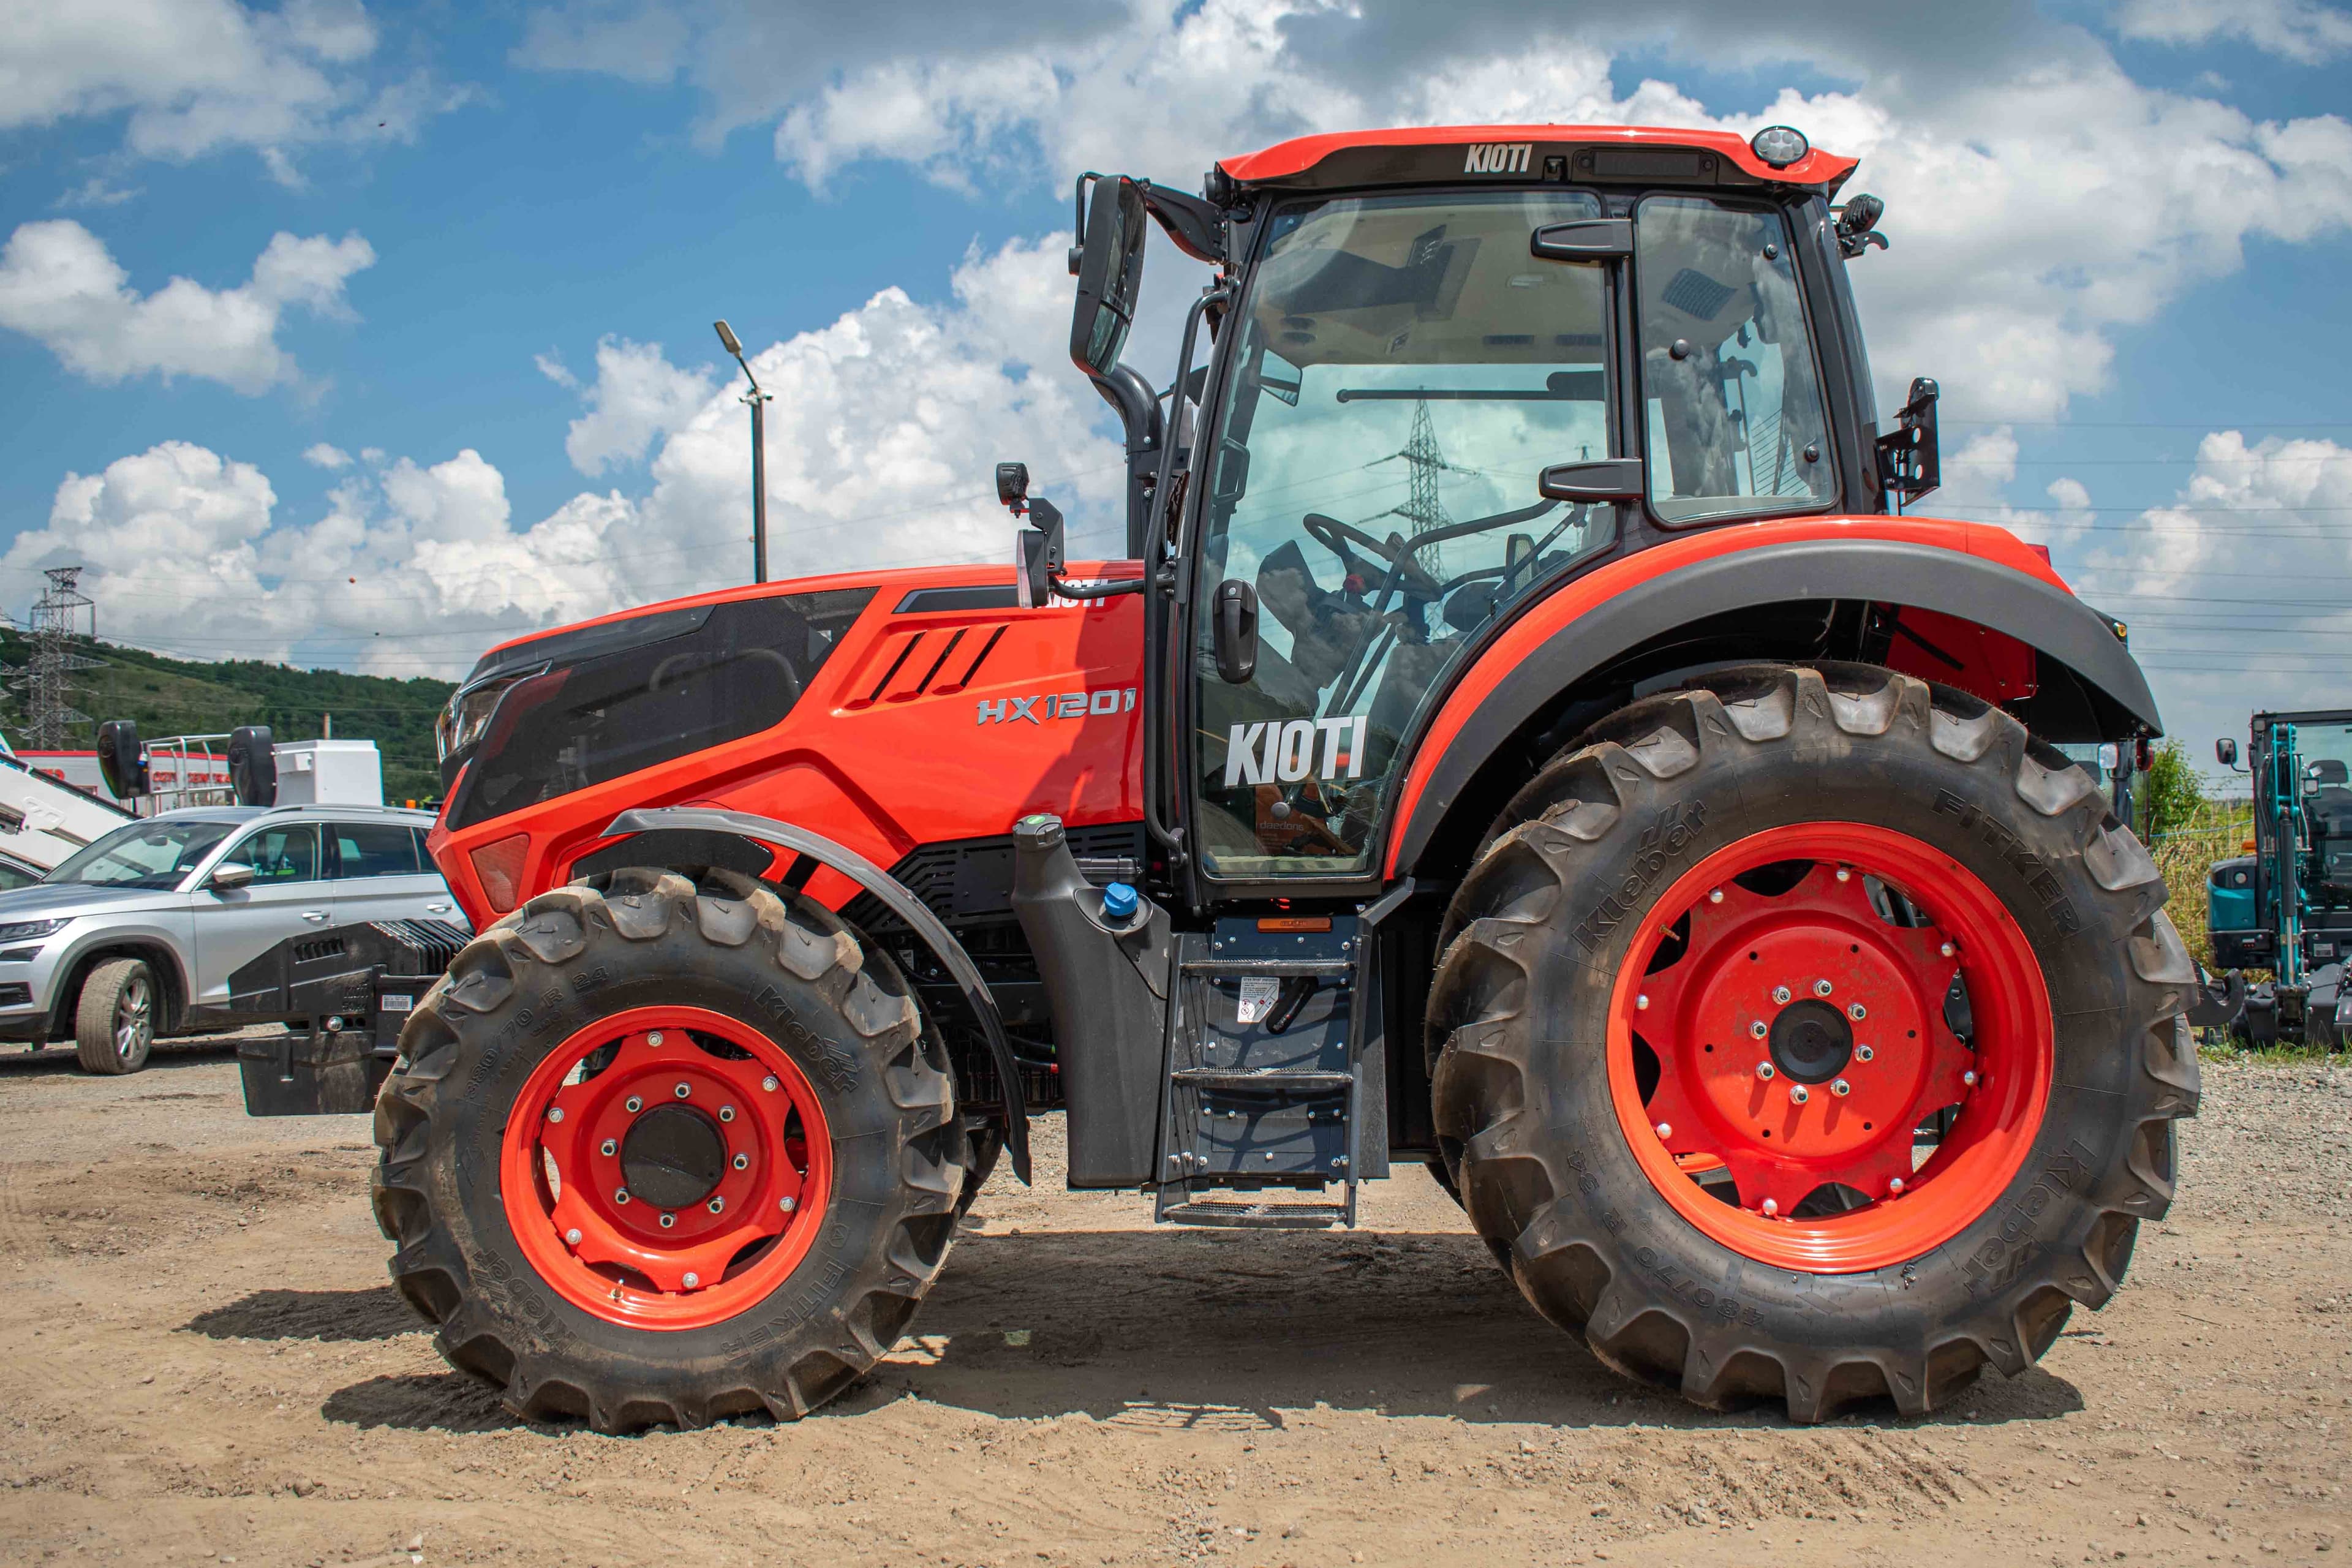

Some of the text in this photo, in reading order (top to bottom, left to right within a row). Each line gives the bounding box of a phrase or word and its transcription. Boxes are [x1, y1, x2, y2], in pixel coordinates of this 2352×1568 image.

[1464, 143, 1532, 173] KIOTI
[1037, 579, 1108, 608] IOTI
[976, 688, 1136, 725] HX1201
[1224, 715, 1368, 787] KIOTI
[1571, 799, 1707, 954] Kleber
[1930, 788, 2081, 938] FITKER
[542, 987, 564, 1008] R
[572, 966, 608, 991] 24
[754, 984, 858, 1093] Kleber
[1567, 1149, 1600, 1196] 34
[1603, 1208, 1627, 1237] R
[1962, 1138, 2097, 1294] Kleber
[472, 1248, 579, 1355] Kleber
[720, 1260, 845, 1361] FITKER
[1635, 1246, 1765, 1327] 480/70
